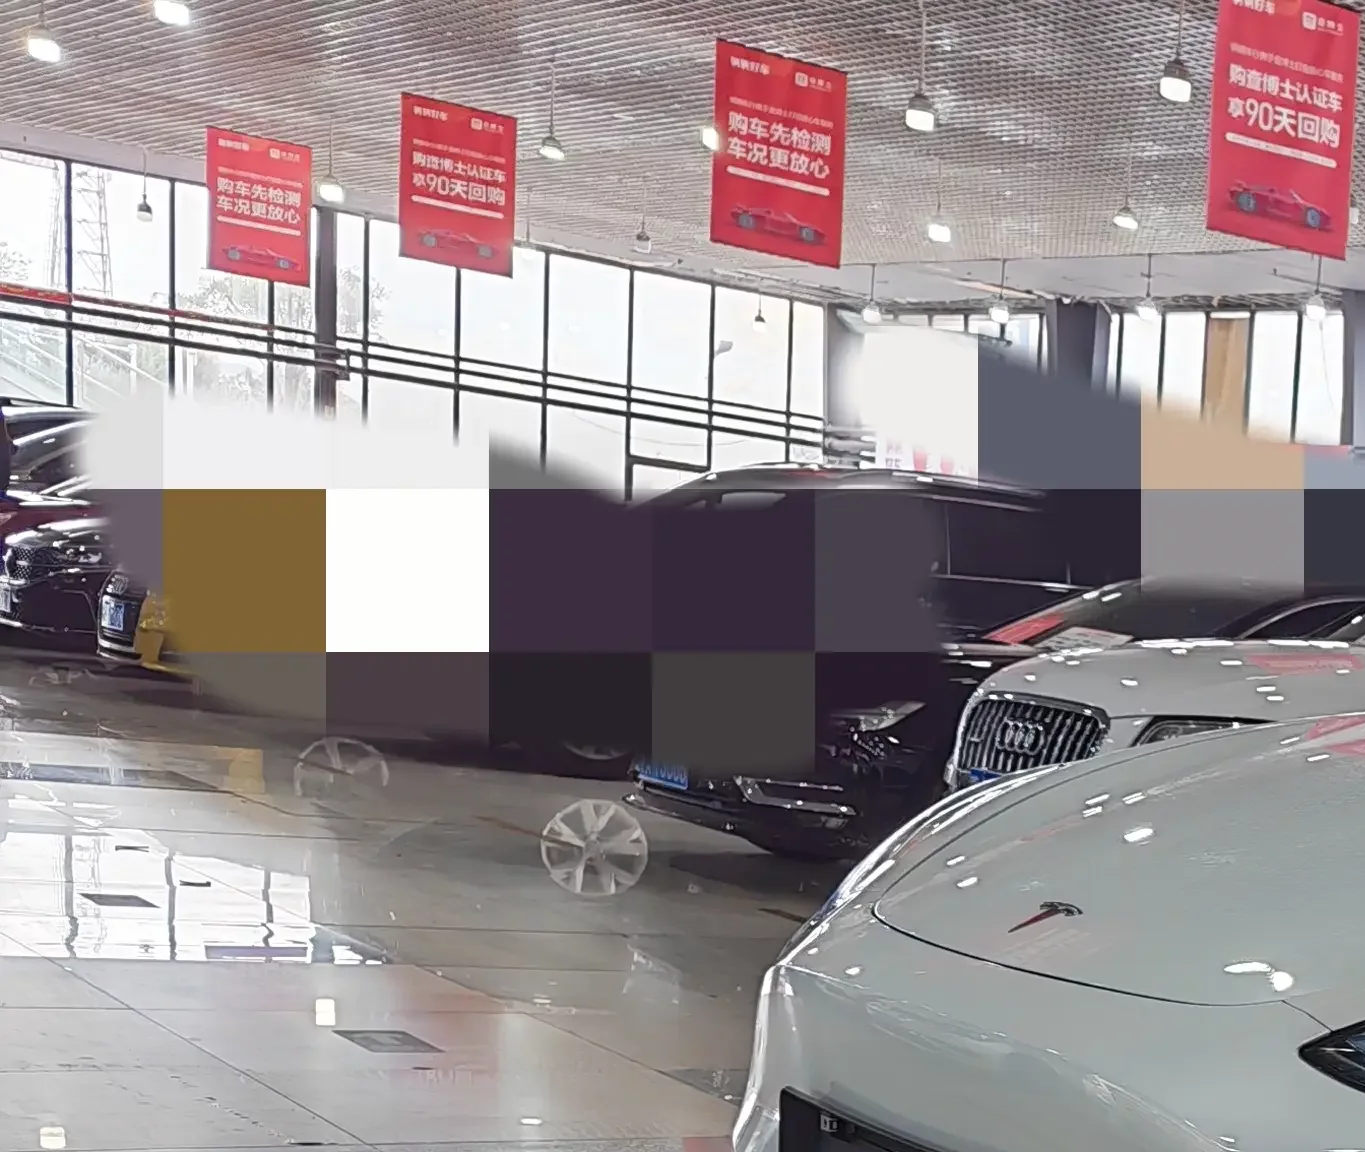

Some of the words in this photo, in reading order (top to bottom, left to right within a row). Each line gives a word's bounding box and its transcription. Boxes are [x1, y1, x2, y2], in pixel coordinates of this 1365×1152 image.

[728, 111, 832, 157] 购车先检测
[1227, 96, 1341, 149] 享90天回购
[727, 136, 831, 180] 车况更放心
[216, 195, 302, 225] 车况更放心
[217, 176, 302, 208] 购车先检测
